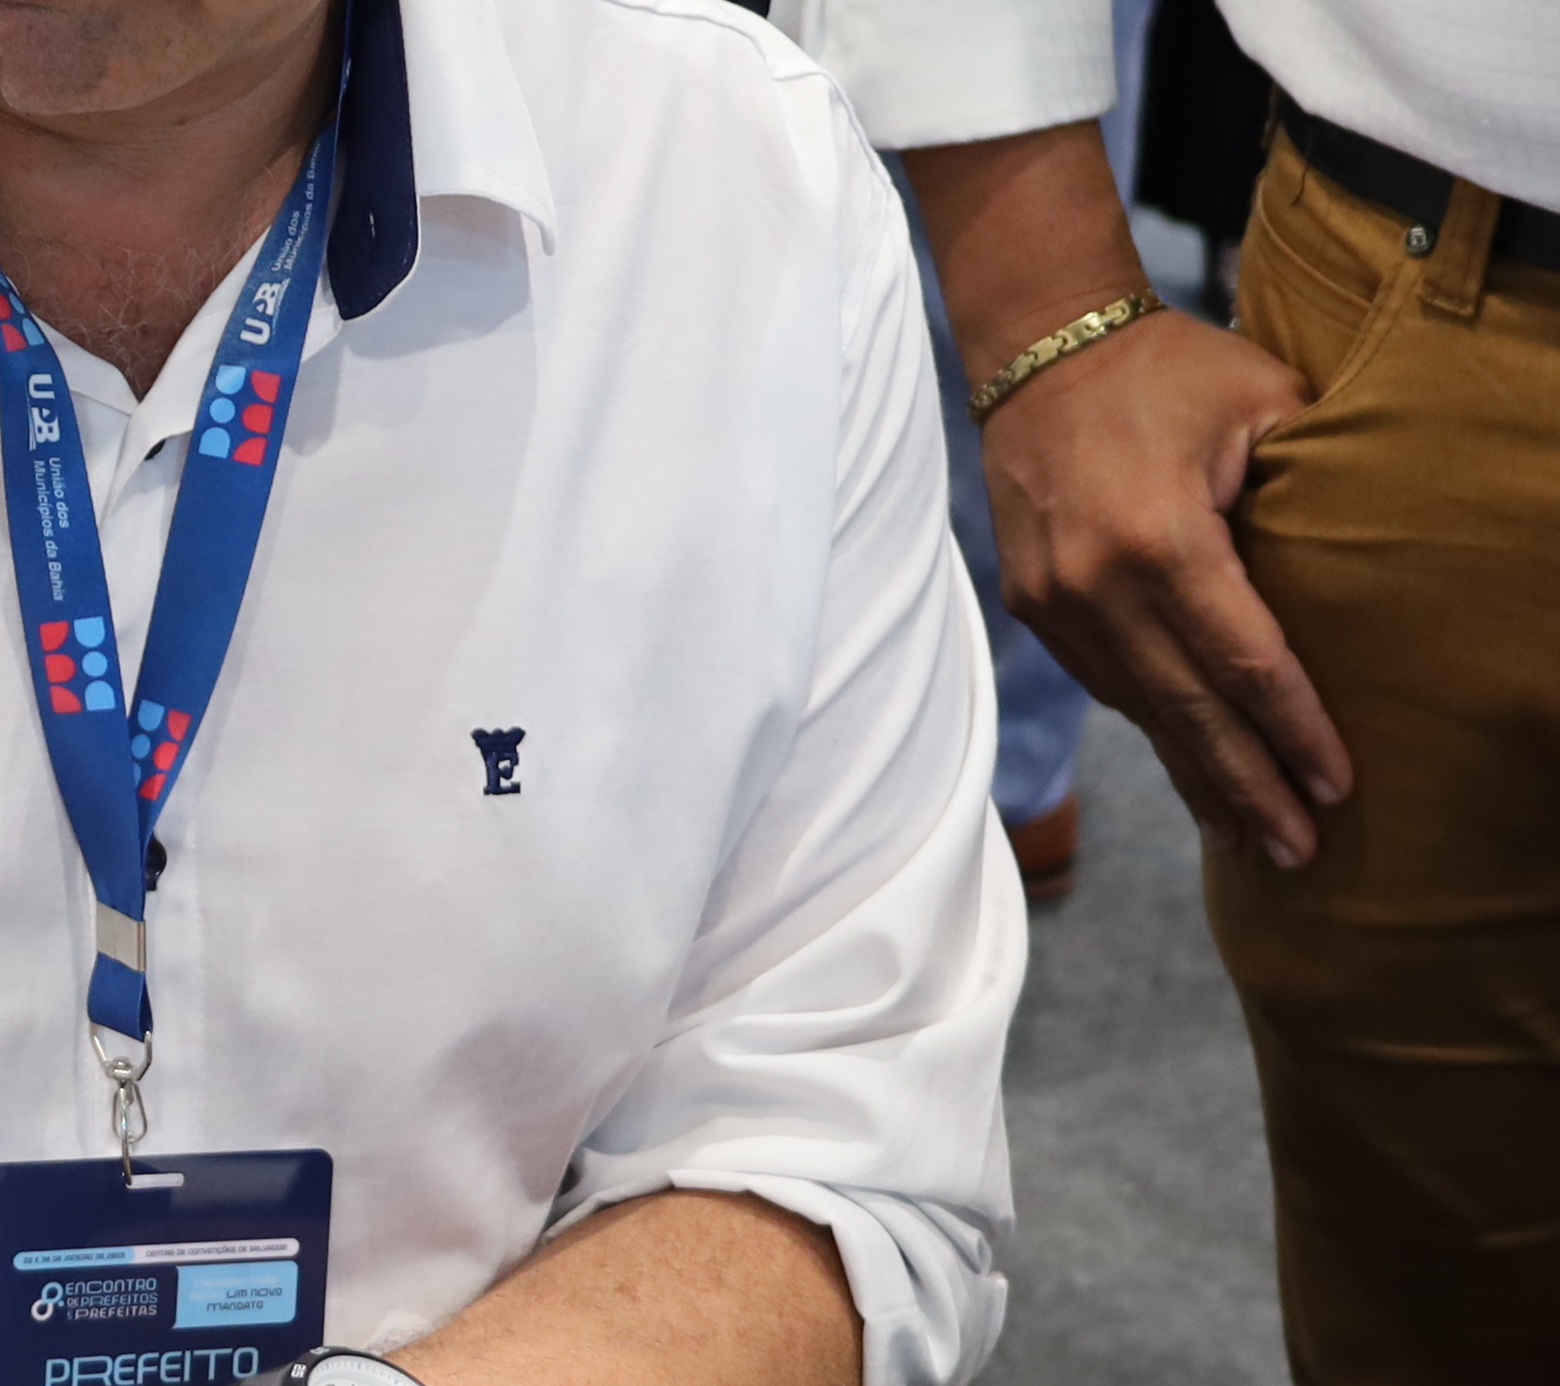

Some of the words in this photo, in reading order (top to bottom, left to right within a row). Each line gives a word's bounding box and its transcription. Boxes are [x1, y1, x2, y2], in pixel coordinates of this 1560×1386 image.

[305, 183, 314, 200] da
[287, 210, 300, 236] dos
[49, 457, 65, 500] União
[33, 460, 54, 538] Municípios
[56, 501, 69, 529] dos
[45, 539, 58, 559] da
[48, 562, 64, 602] Bahia
[66, 1278, 157, 1296] ENCONTRO
[226, 1289, 248, 1299] UM
[250, 1287, 282, 1297] NOVO
[67, 1297, 79, 1308] DE
[80, 1292, 158, 1307] PREFEITOS
[206, 1300, 263, 1311] MANDATO
[74, 1305, 157, 1320] PREFEITAS
